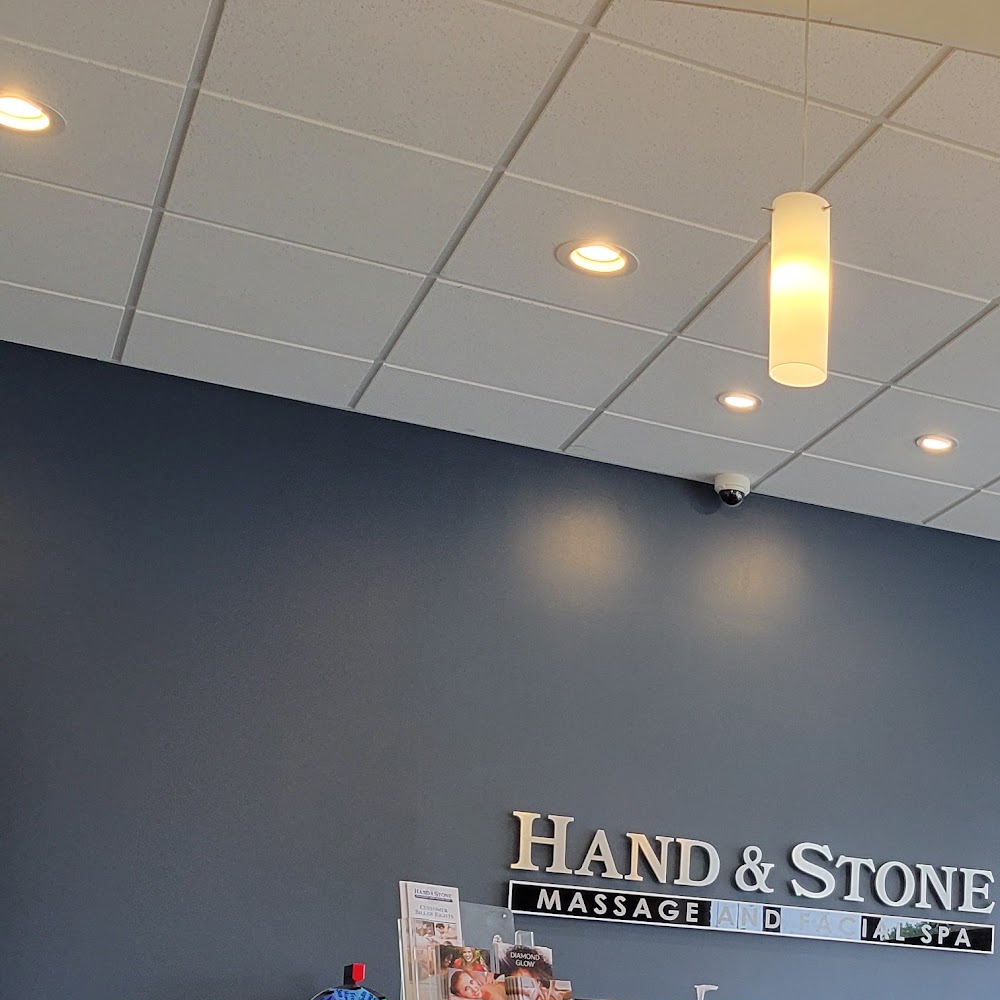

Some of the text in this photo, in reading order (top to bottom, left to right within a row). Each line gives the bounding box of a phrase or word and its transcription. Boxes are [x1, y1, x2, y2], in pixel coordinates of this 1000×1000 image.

[510, 811, 996, 914] HAND & STONE
[536, 889, 699, 923] MASSAGE
[716, 905, 781, 930] AND
[920, 924, 972, 948] SPA
[510, 951, 541, 968] DIAMOND GLOW
